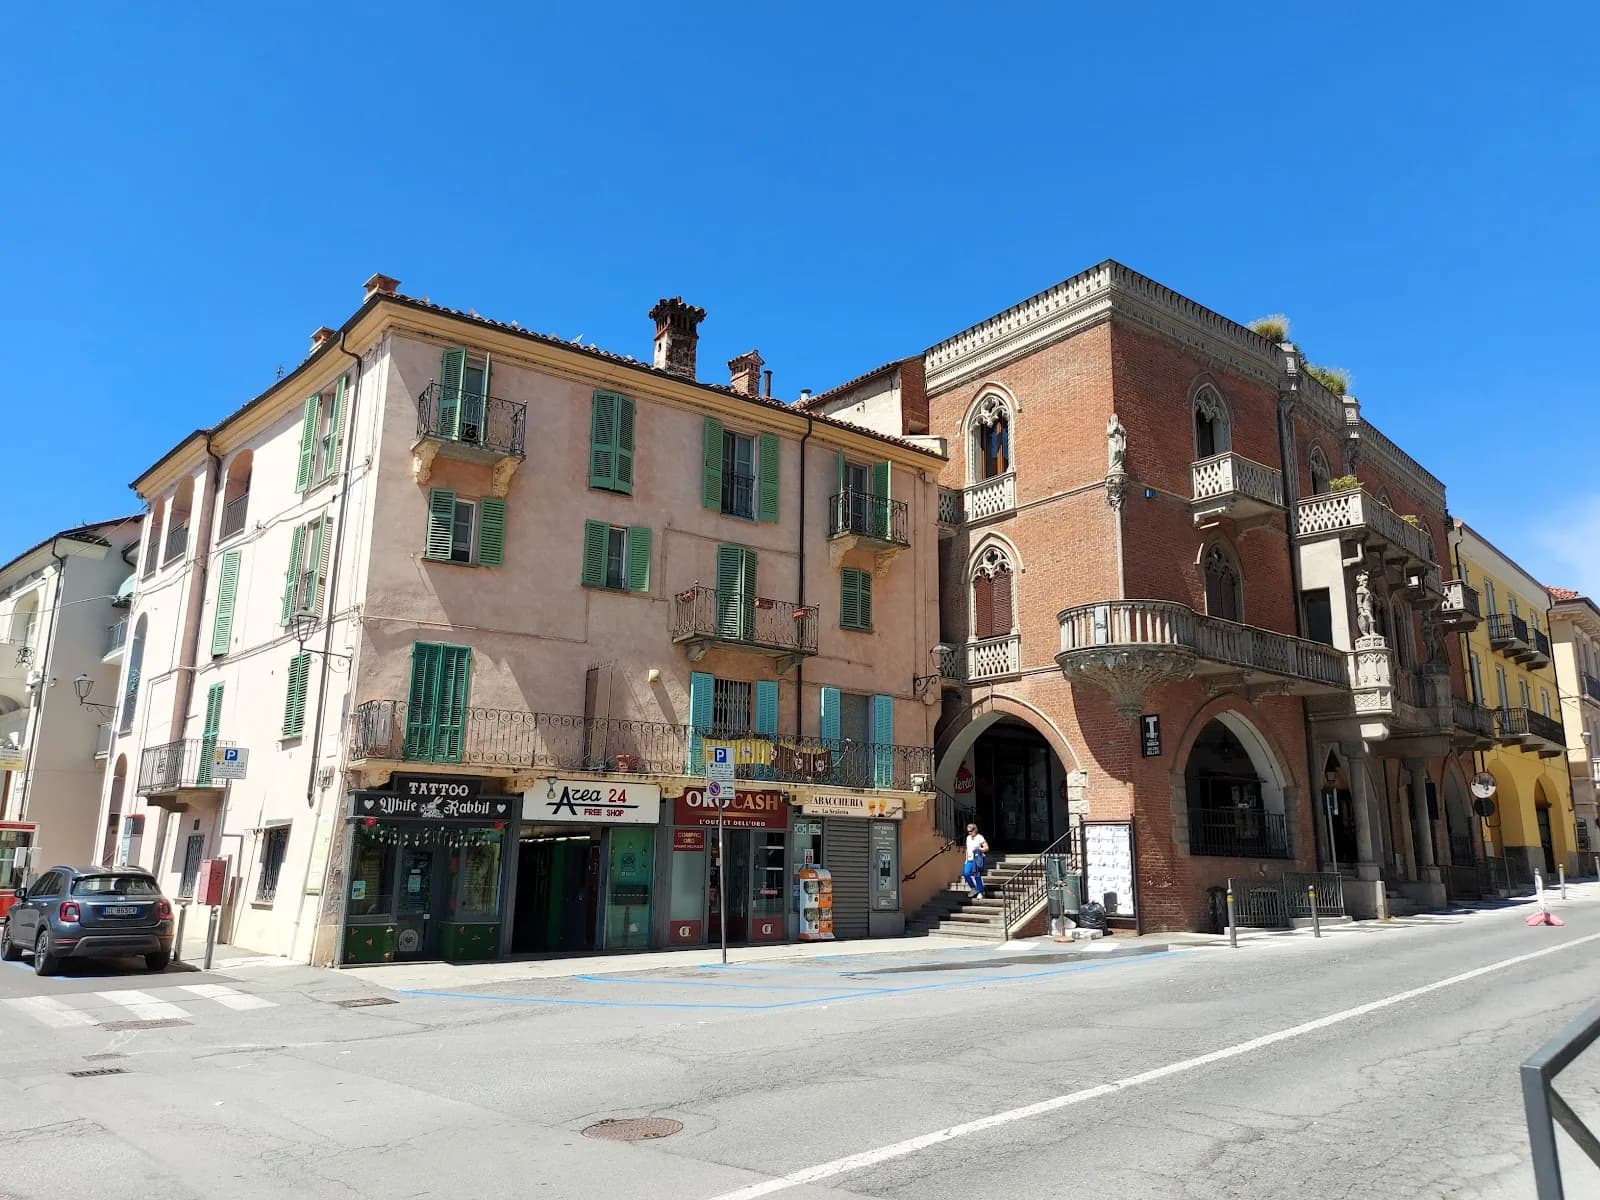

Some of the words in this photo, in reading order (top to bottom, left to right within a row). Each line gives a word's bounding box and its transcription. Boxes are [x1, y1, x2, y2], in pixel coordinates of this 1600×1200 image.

[226, 750, 237, 760] P
[716, 749, 725, 762] P
[408, 781, 470, 797] TATTOO
[443, 799, 490, 817] Rabbit
[552, 786, 602, 816] Area
[608, 788, 628, 804] 24
[583, 808, 603, 817] FREE
[606, 808, 625, 817] SHOP
